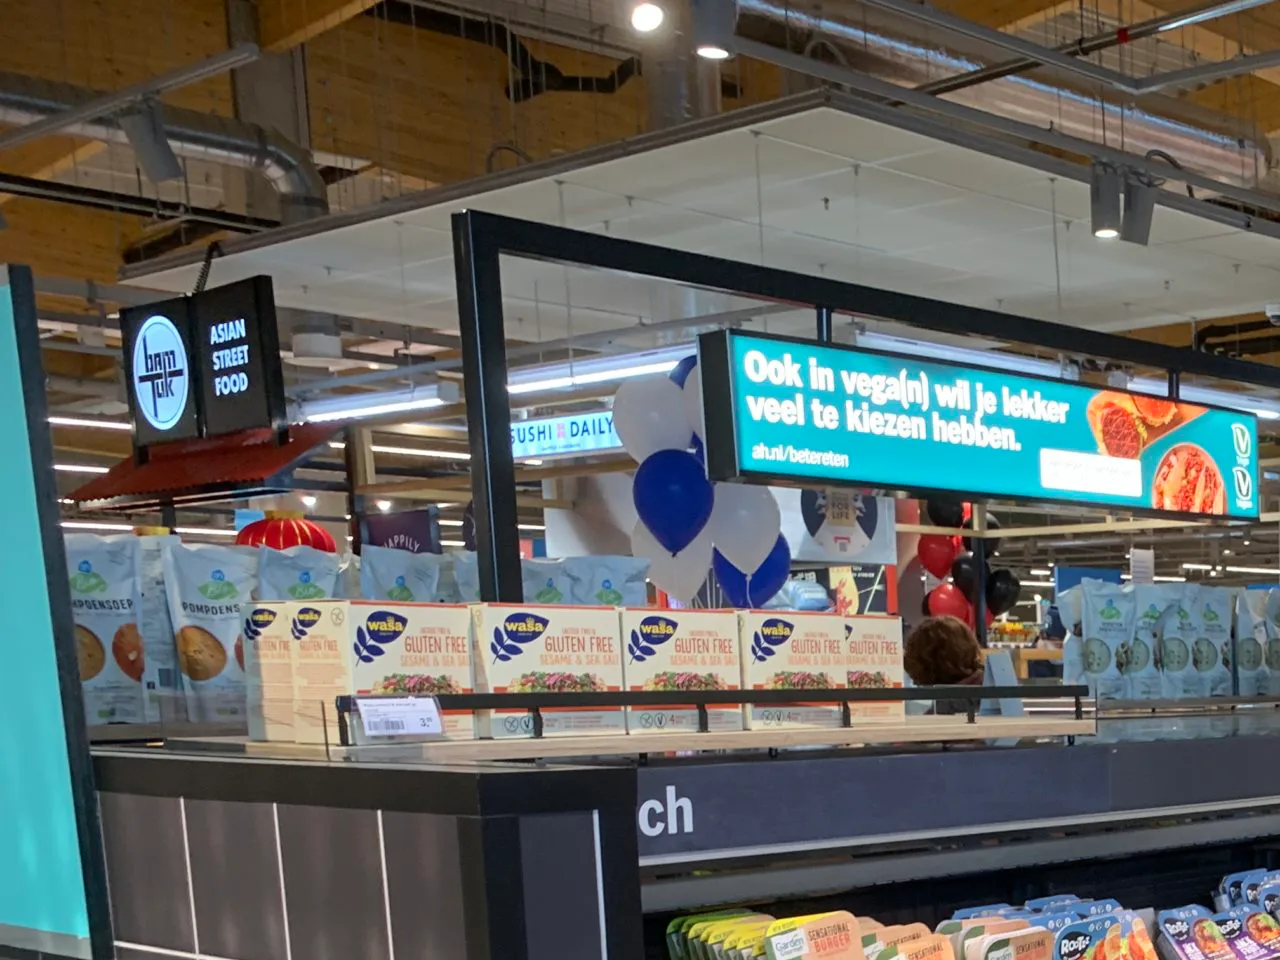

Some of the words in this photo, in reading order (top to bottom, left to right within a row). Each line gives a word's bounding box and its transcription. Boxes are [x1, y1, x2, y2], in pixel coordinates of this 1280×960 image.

[210, 318, 245, 345] ASIAN
[213, 345, 249, 371] STREET
[215, 372, 248, 397] FOOD
[744, 350, 803, 388] Ook
[808, 356, 835, 392] in
[840, 368, 929, 412] vega(n)
[934, 380, 970, 410] wil
[974, 382, 997, 417] je
[1002, 386, 1070, 424] lekker
[571, 417, 613, 437] DAILY
[746, 394, 804, 426] veel
[810, 399, 839, 430] te
[846, 401, 926, 440] kiezen
[932, 411, 1021, 451] hebben.
[752, 442, 849, 468] ah.nl/betereten
[367, 620, 404, 631] wasa
[504, 621, 544, 632] wasa
[640, 623, 674, 634] wasa
[762, 626, 790, 636] wasa
[405, 636, 441, 654] GLUTEN
[445, 636, 467, 653] FREE
[545, 636, 585, 653] GLUTEN
[590, 636, 614, 653] FREE
[675, 637, 709, 654] GLUTEN
[713, 638, 733, 654] FREE
[791, 640, 820, 655] GLUTEN
[823, 640, 841, 655] FREE
[850, 642, 878, 655] GLUTEN
[881, 642, 898, 656] FREE
[540, 655, 572, 666] SESAME
[587, 655, 600, 666] SEA
[808, 922, 850, 941] SENSATIONAL
[775, 937, 804, 952] Garden
[814, 932, 851, 953] BURGER
